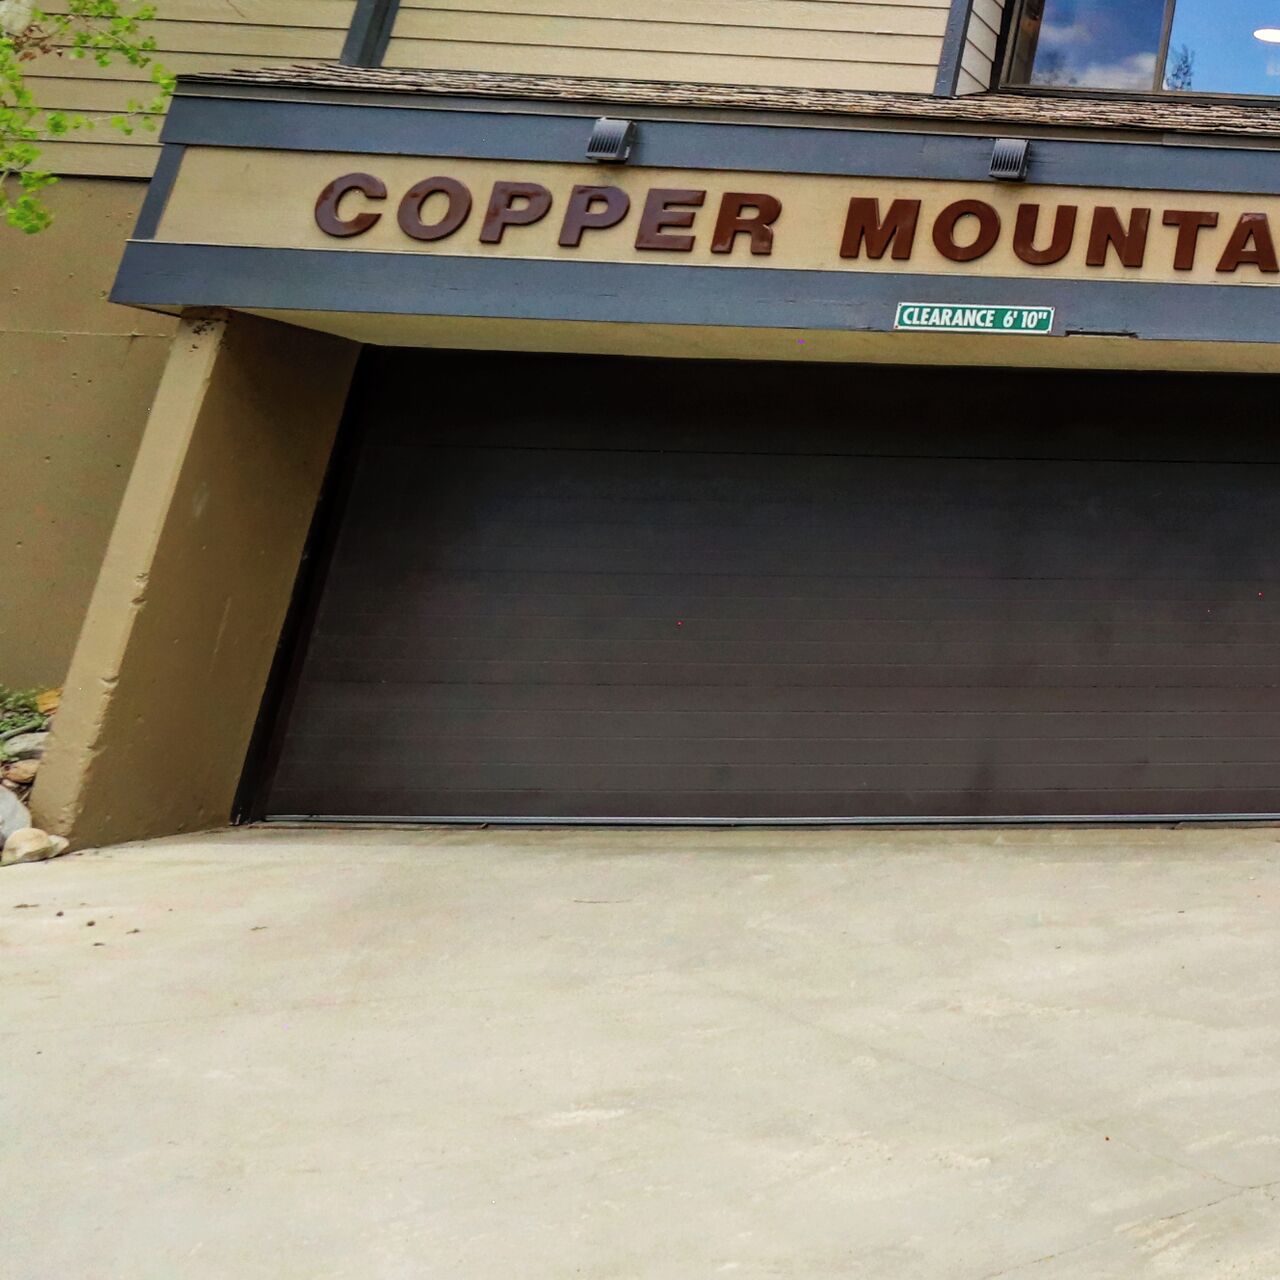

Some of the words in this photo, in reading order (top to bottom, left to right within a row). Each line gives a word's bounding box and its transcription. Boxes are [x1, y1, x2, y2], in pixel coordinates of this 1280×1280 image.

[314, 172, 783, 257] COPPER
[903, 307, 996, 327] CLEARANCE
[1003, 311, 1017, 328] 6'
[1021, 311, 1048, 328] 10"
